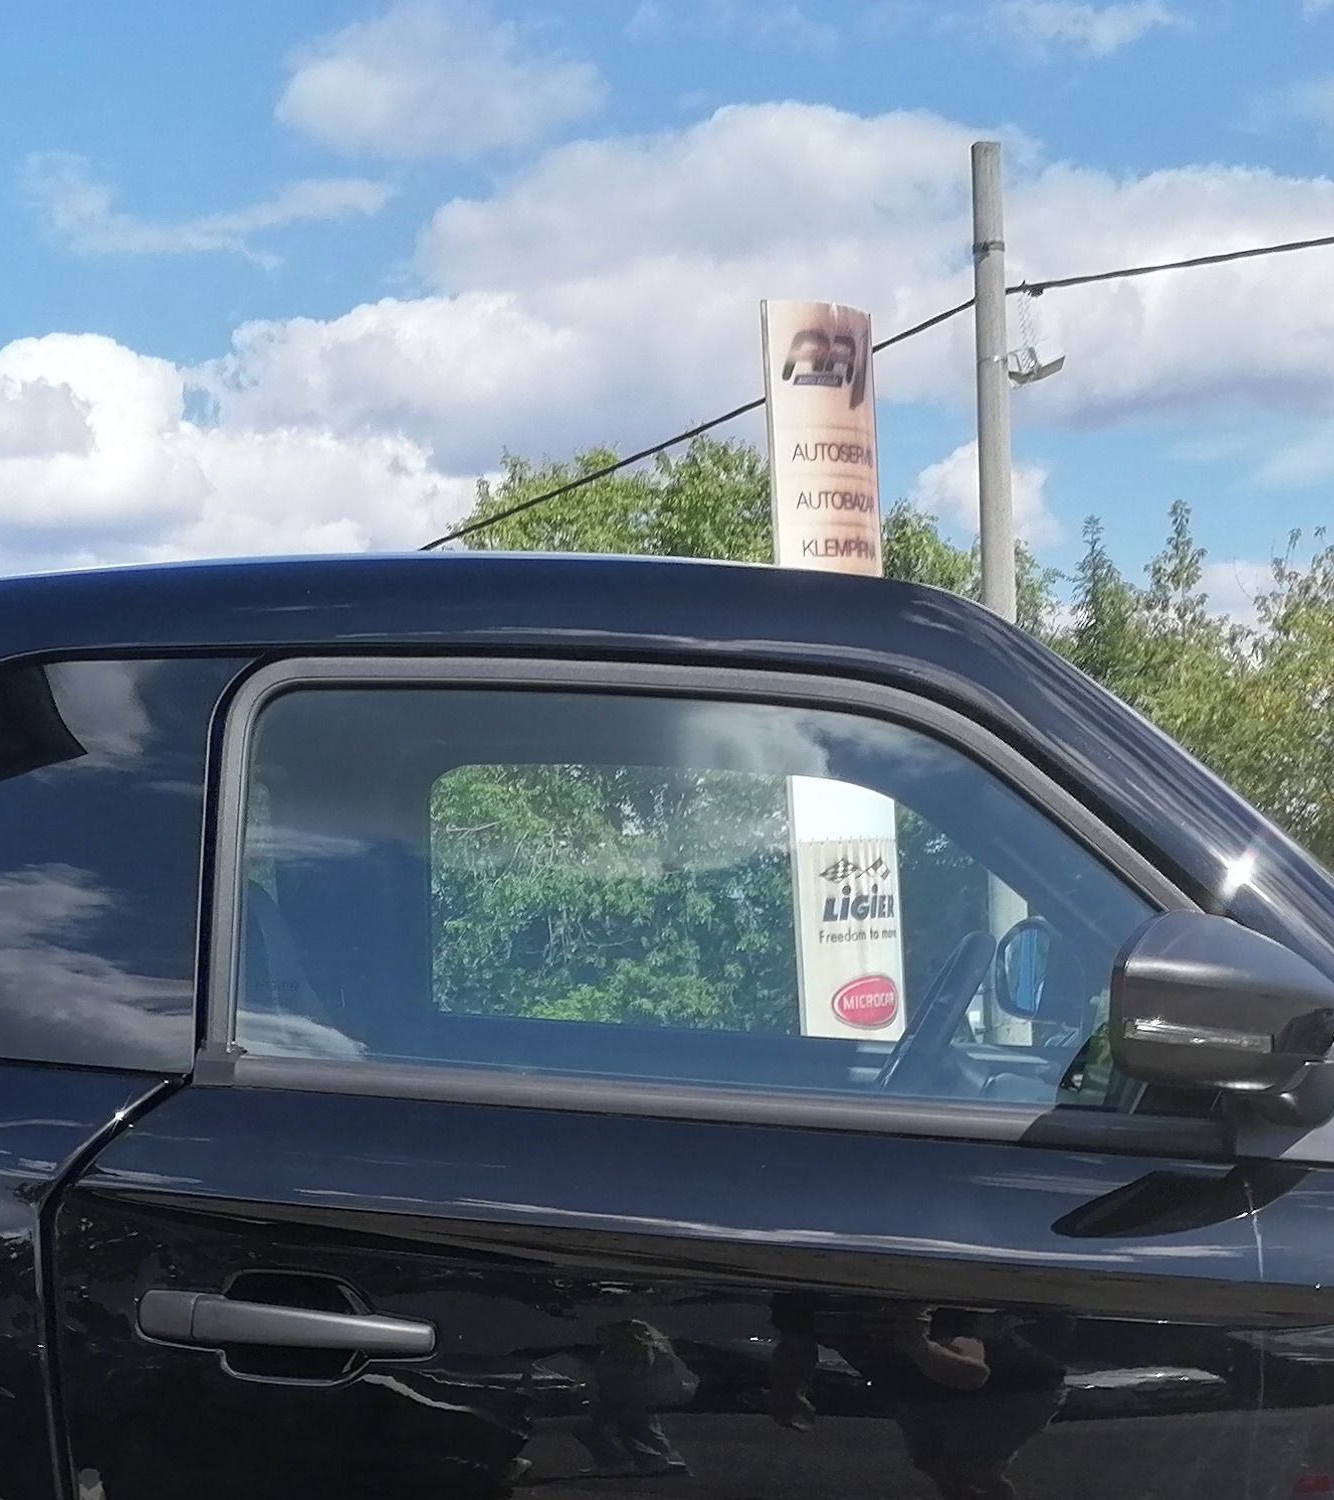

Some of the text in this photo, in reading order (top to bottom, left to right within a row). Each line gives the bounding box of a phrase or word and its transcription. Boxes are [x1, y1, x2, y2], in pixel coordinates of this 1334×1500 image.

[802, 536, 875, 561] KLEMPÍRN
[819, 927, 866, 944] Freedom
[870, 929, 879, 939] to
[843, 991, 895, 1010] MICROCAR
